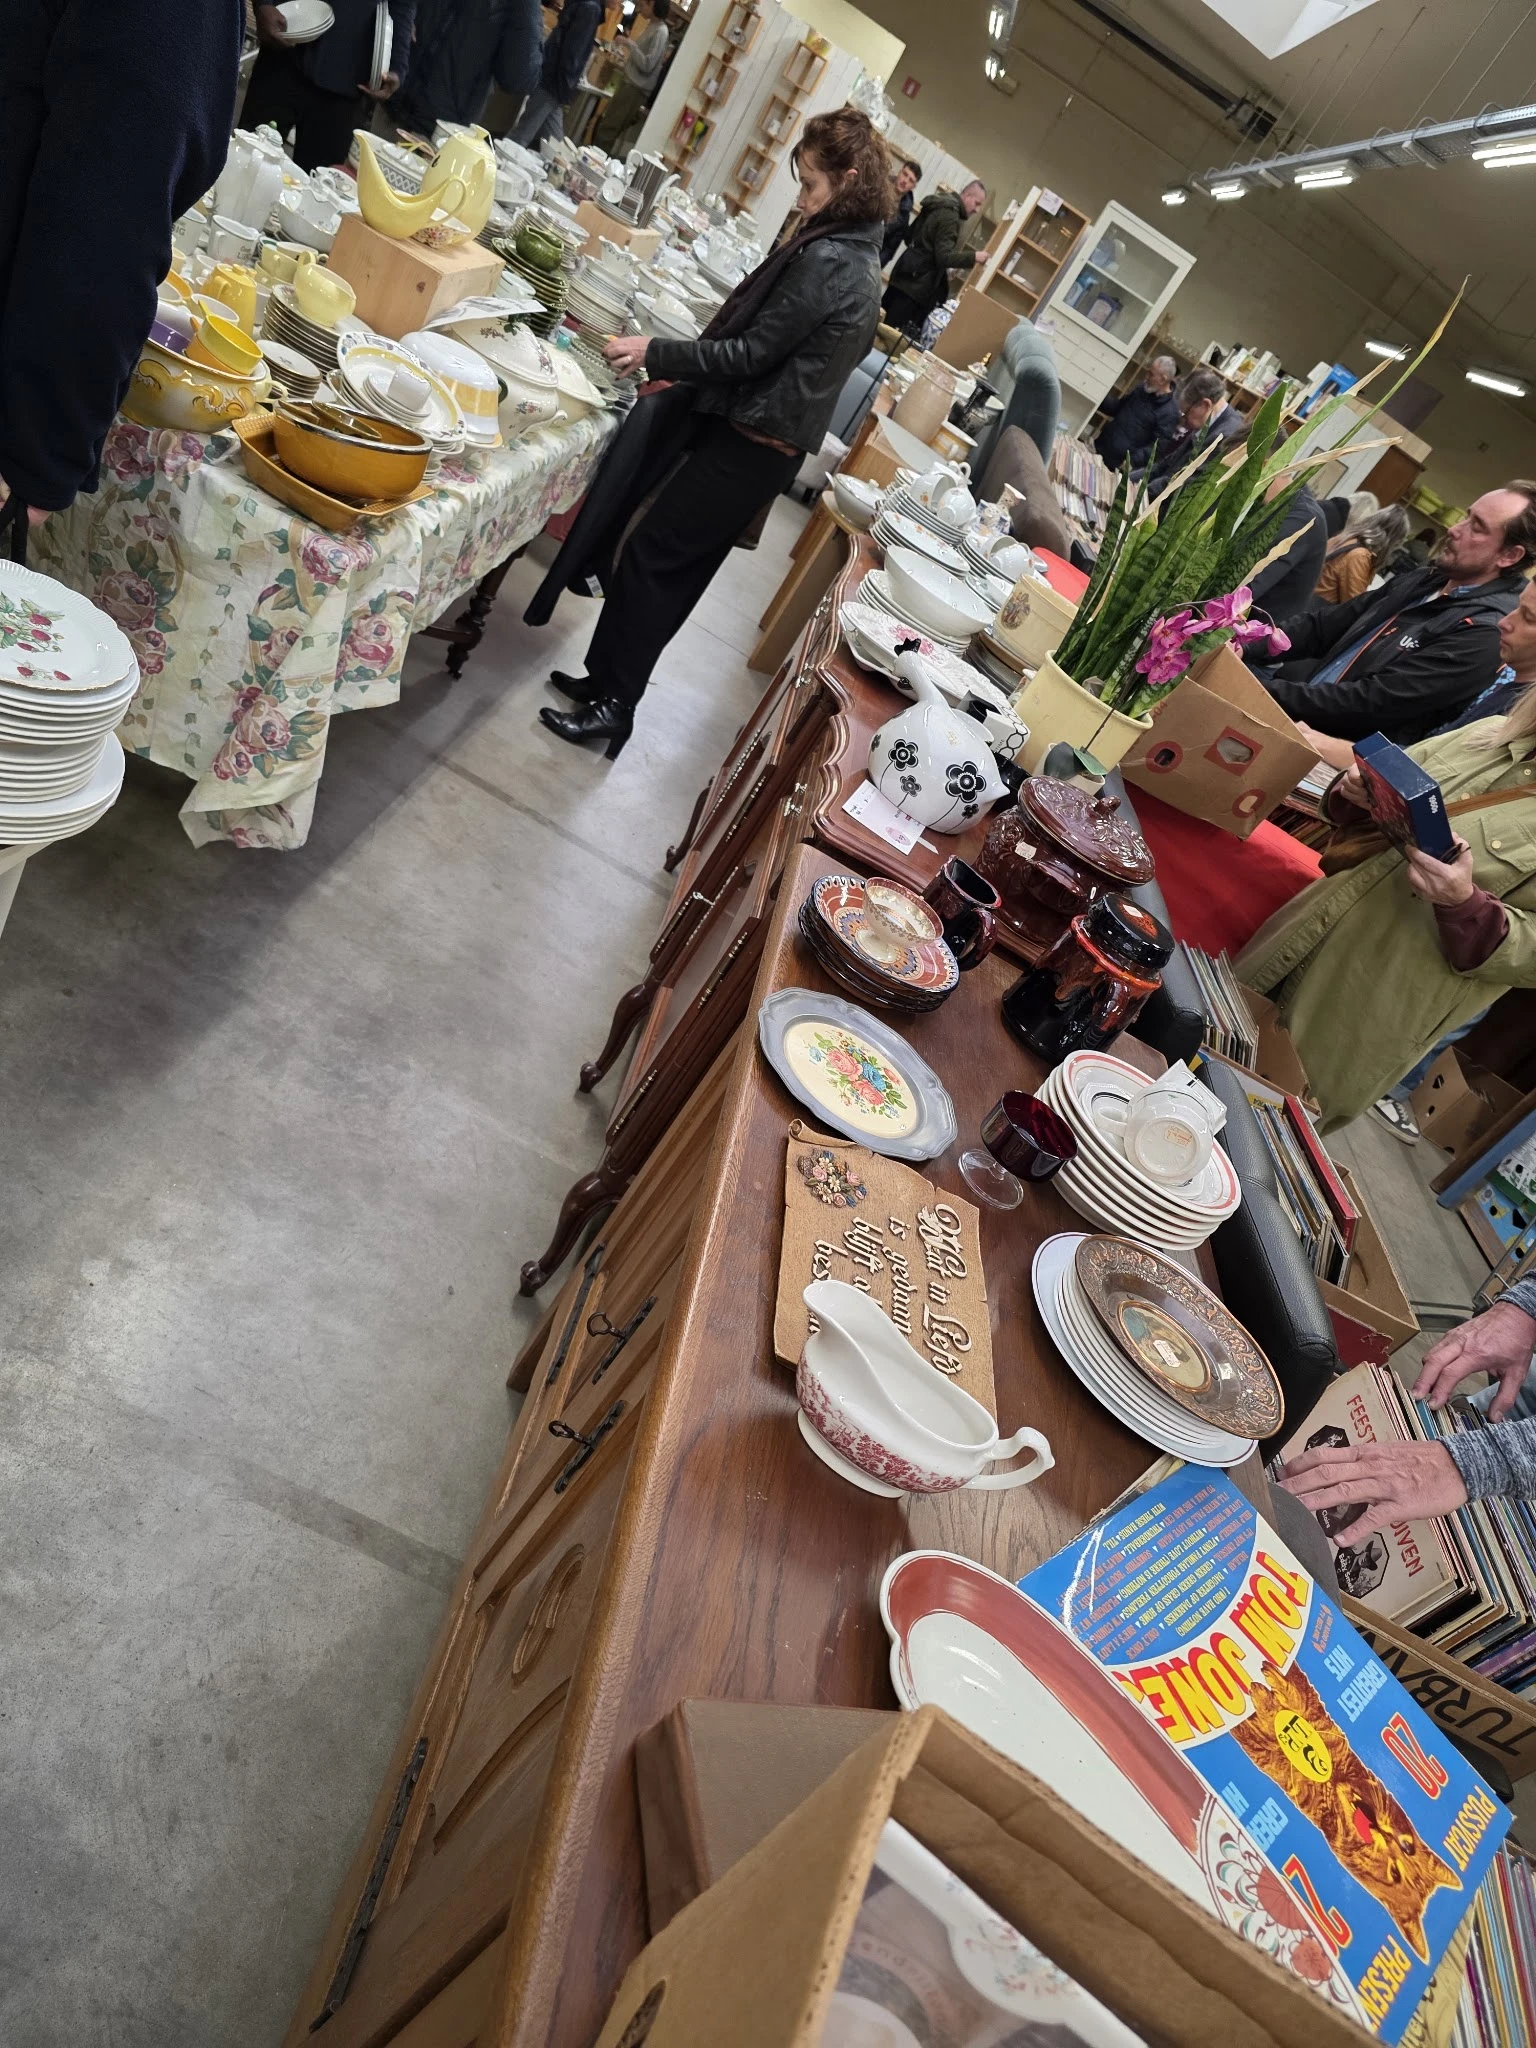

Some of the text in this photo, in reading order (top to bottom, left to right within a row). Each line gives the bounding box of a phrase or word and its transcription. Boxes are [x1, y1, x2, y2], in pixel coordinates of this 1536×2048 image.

[843, 1217, 884, 1275] blijft
[882, 1216, 918, 1334] is gedaan
[928, 1282, 950, 1305] in
[923, 1303, 971, 1376] Liefd
[1346, 1394, 1377, 1443] FEEST
[1193, 1489, 1209, 1503] MAKE
[1205, 1484, 1215, 1493] TO
[1216, 1491, 1229, 1503] I'LL
[1181, 1500, 1193, 1511] BIG
[1189, 1497, 1197, 1505] A
[1202, 1498, 1220, 1514] NEVER
[1228, 1498, 1243, 1512] LOVE
[1162, 1513, 1175, 1526] CRY
[1172, 1506, 1185, 1519] MAN
[1184, 1517, 1194, 1527] IN
[1190, 1508, 1206, 1523] FALL
[1204, 1512, 1226, 1532] TONIGHT
[1222, 1507, 1232, 1517] ME
[1237, 1509, 1253, 1523] HELP
[1101, 1502, 1166, 1551] WITH THESE HANDS TILL
[1171, 1521, 1188, 1537] LOVE
[1217, 1518, 1241, 1540] YOURSELF
[1241, 1527, 1254, 1539] IT'S
[1122, 1522, 1162, 1555] THUNDERBALL
[1156, 1531, 1175, 1549] AGAIN
[1180, 1528, 1205, 1550] WITHOUT
[1198, 1537, 1217, 1555] FUNNY
[1232, 1533, 1245, 1546] NOT
[1101, 1551, 1124, 1572] WHAT'S
[1122, 1548, 1153, 1574] SOMETHIN'
[1167, 1544, 1184, 1560] LOVE
[1177, 1549, 1202, 1572] FAMILIAR
[1212, 1541, 1236, 1562] UNUSUAL
[1142, 1568, 1152, 1580] IS
[1148, 1554, 1171, 1575] (THERE
[1193, 1560, 1213, 1579] GREEN
[1094, 1581, 1108, 1596] YOU
[1118, 1572, 1147, 1598] NOTHING)
[1147, 1566, 1181, 1596] FORGOTTEN
[1176, 1573, 1197, 1593] GREEN
[1121, 1591, 1151, 1618] FEELINGS
[1124, 1550, 1248, 1660] DELILAH DAUGHTER OF DARKNESS ONLY ONCE
[1153, 1599, 1165, 1613] OF
[1161, 1586, 1181, 1606] GRASS
[1088, 1595, 1119, 1623] PLEDGING
[1138, 1606, 1157, 1625] HOME
[1174, 1586, 1230, 1637] I (WHO HAVE NOTHING)
[1079, 1616, 1091, 1630] MY
[1110, 1614, 1123, 1628] I'M
[1089, 1621, 1114, 1644] COMING
[1112, 1636, 1121, 1647] A
[1116, 1624, 1136, 1644] SHE'S
[1096, 1640, 1116, 1661] LADY
[1110, 1551, 1308, 1743] TOM JONE
[1220, 1643, 1355, 1819] HITS HI
[1244, 1658, 1387, 1854] GREATEST GREA
[1299, 1741, 1330, 1780] 2
[1378, 1710, 1450, 1804] 20
[1441, 1783, 1497, 1872] PUSSYCAT
